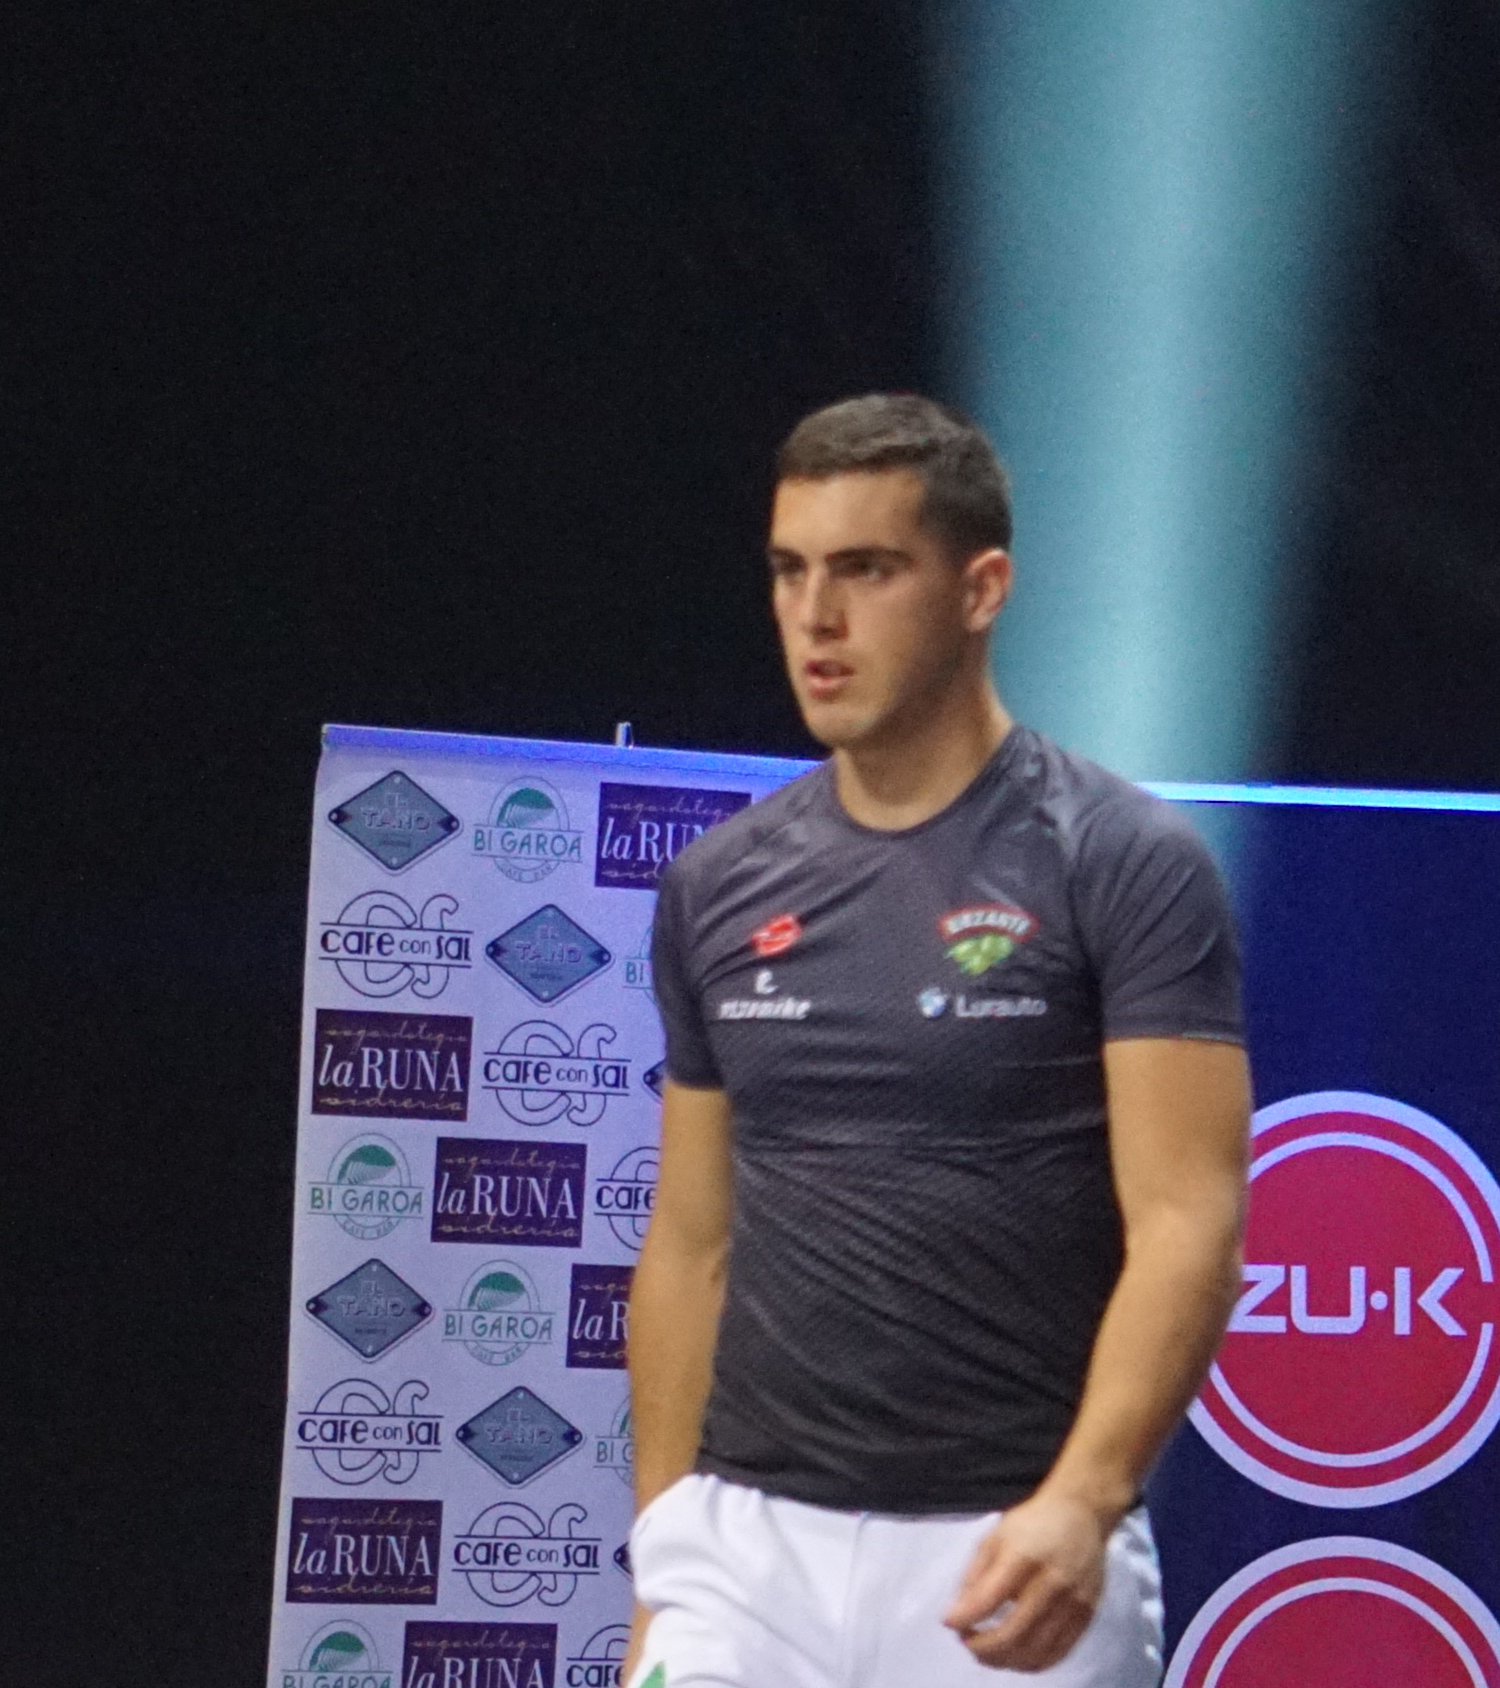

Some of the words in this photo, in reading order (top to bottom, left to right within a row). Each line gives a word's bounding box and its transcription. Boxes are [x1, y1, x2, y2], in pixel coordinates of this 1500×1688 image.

[473, 829, 492, 848] BI
[501, 831, 583, 860] GAROA
[400, 938, 432, 955] con
[359, 1047, 464, 1093] RUNA
[556, 1066, 588, 1083] con
[310, 1187, 332, 1210] BI
[342, 1188, 423, 1214] GAROA
[470, 1174, 577, 1219] RUNA
[445, 1314, 463, 1337] BI
[472, 1315, 553, 1341] GAROA
[373, 1426, 402, 1441] con
[333, 1534, 434, 1576] RUNA
[526, 1549, 558, 1562] con
